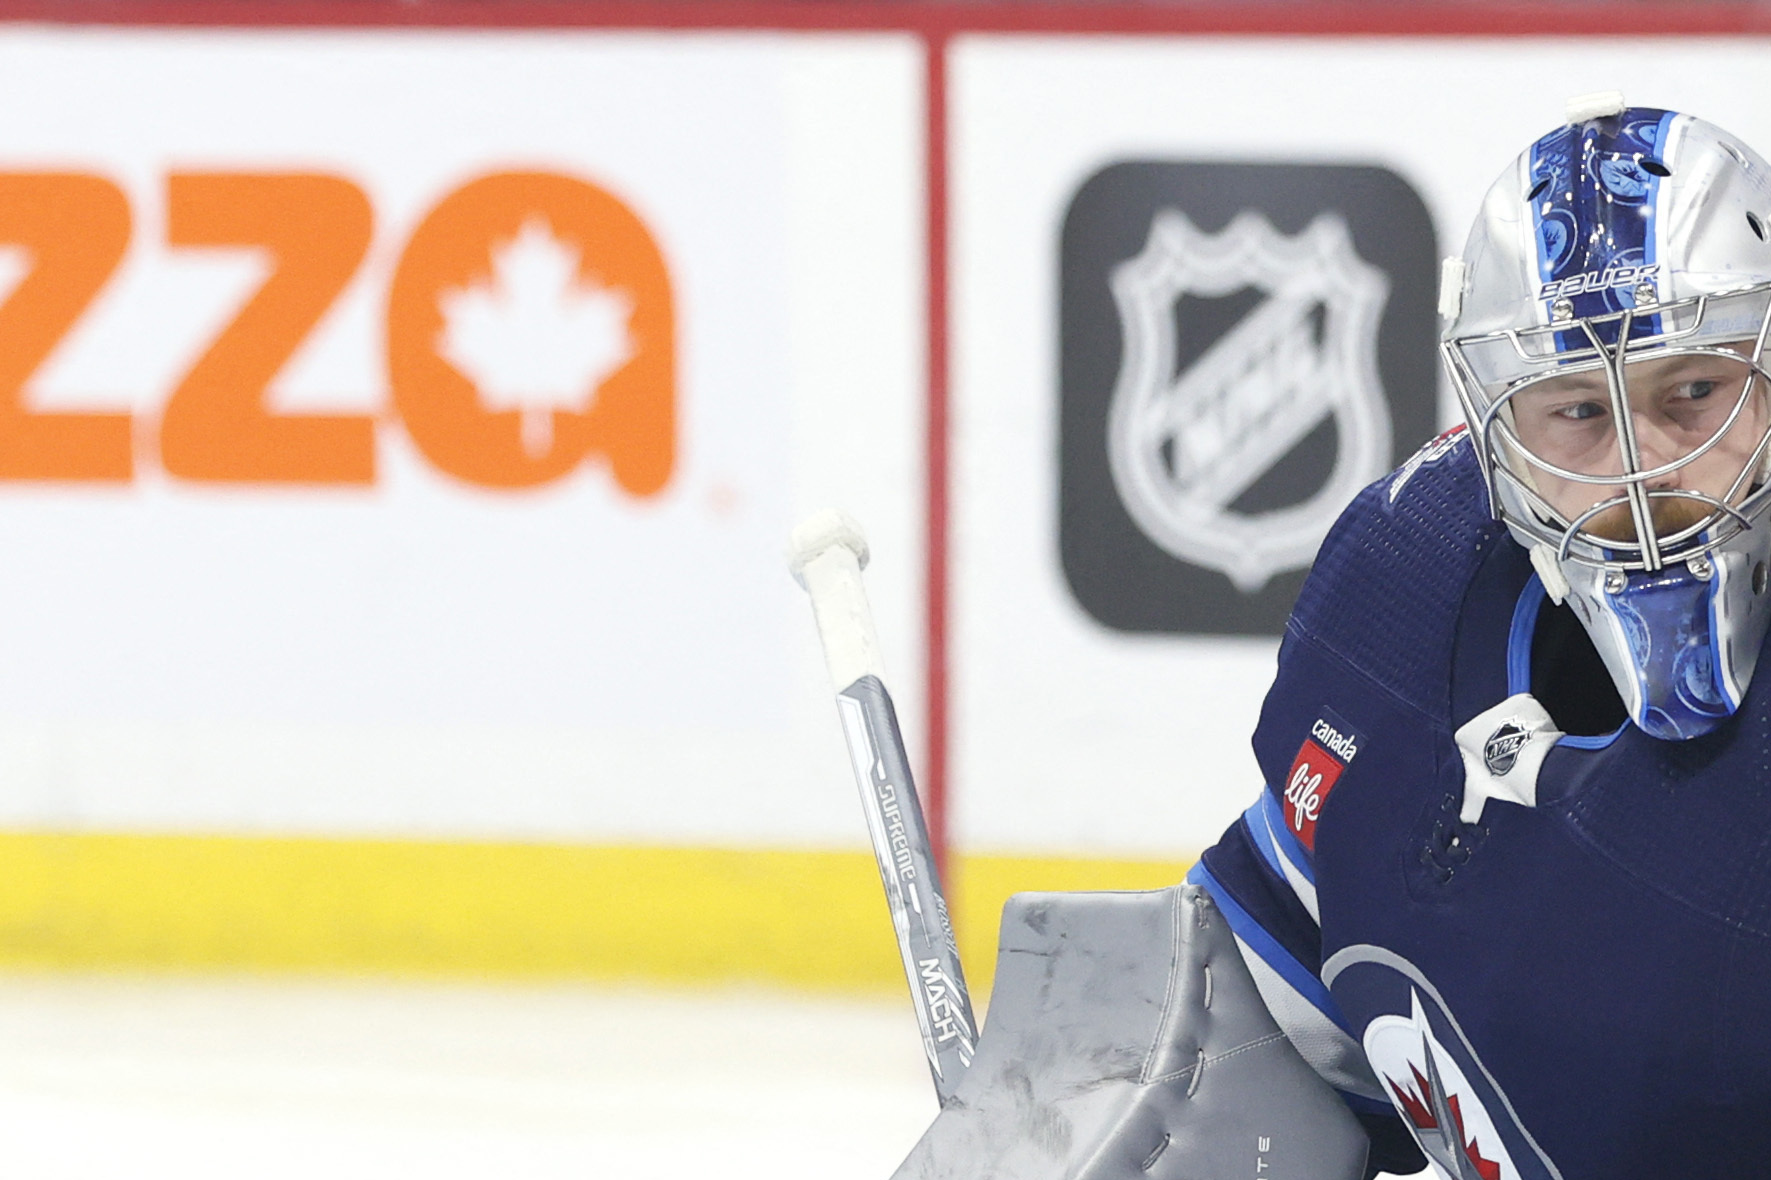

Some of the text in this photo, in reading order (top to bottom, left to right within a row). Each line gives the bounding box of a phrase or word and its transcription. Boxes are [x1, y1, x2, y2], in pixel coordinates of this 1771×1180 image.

[1311, 717, 1358, 764] canada
[1488, 736, 1521, 759] NHL
[1284, 762, 1323, 831] life
[878, 784, 917, 882] SUPREME
[919, 957, 956, 1043] MACH
